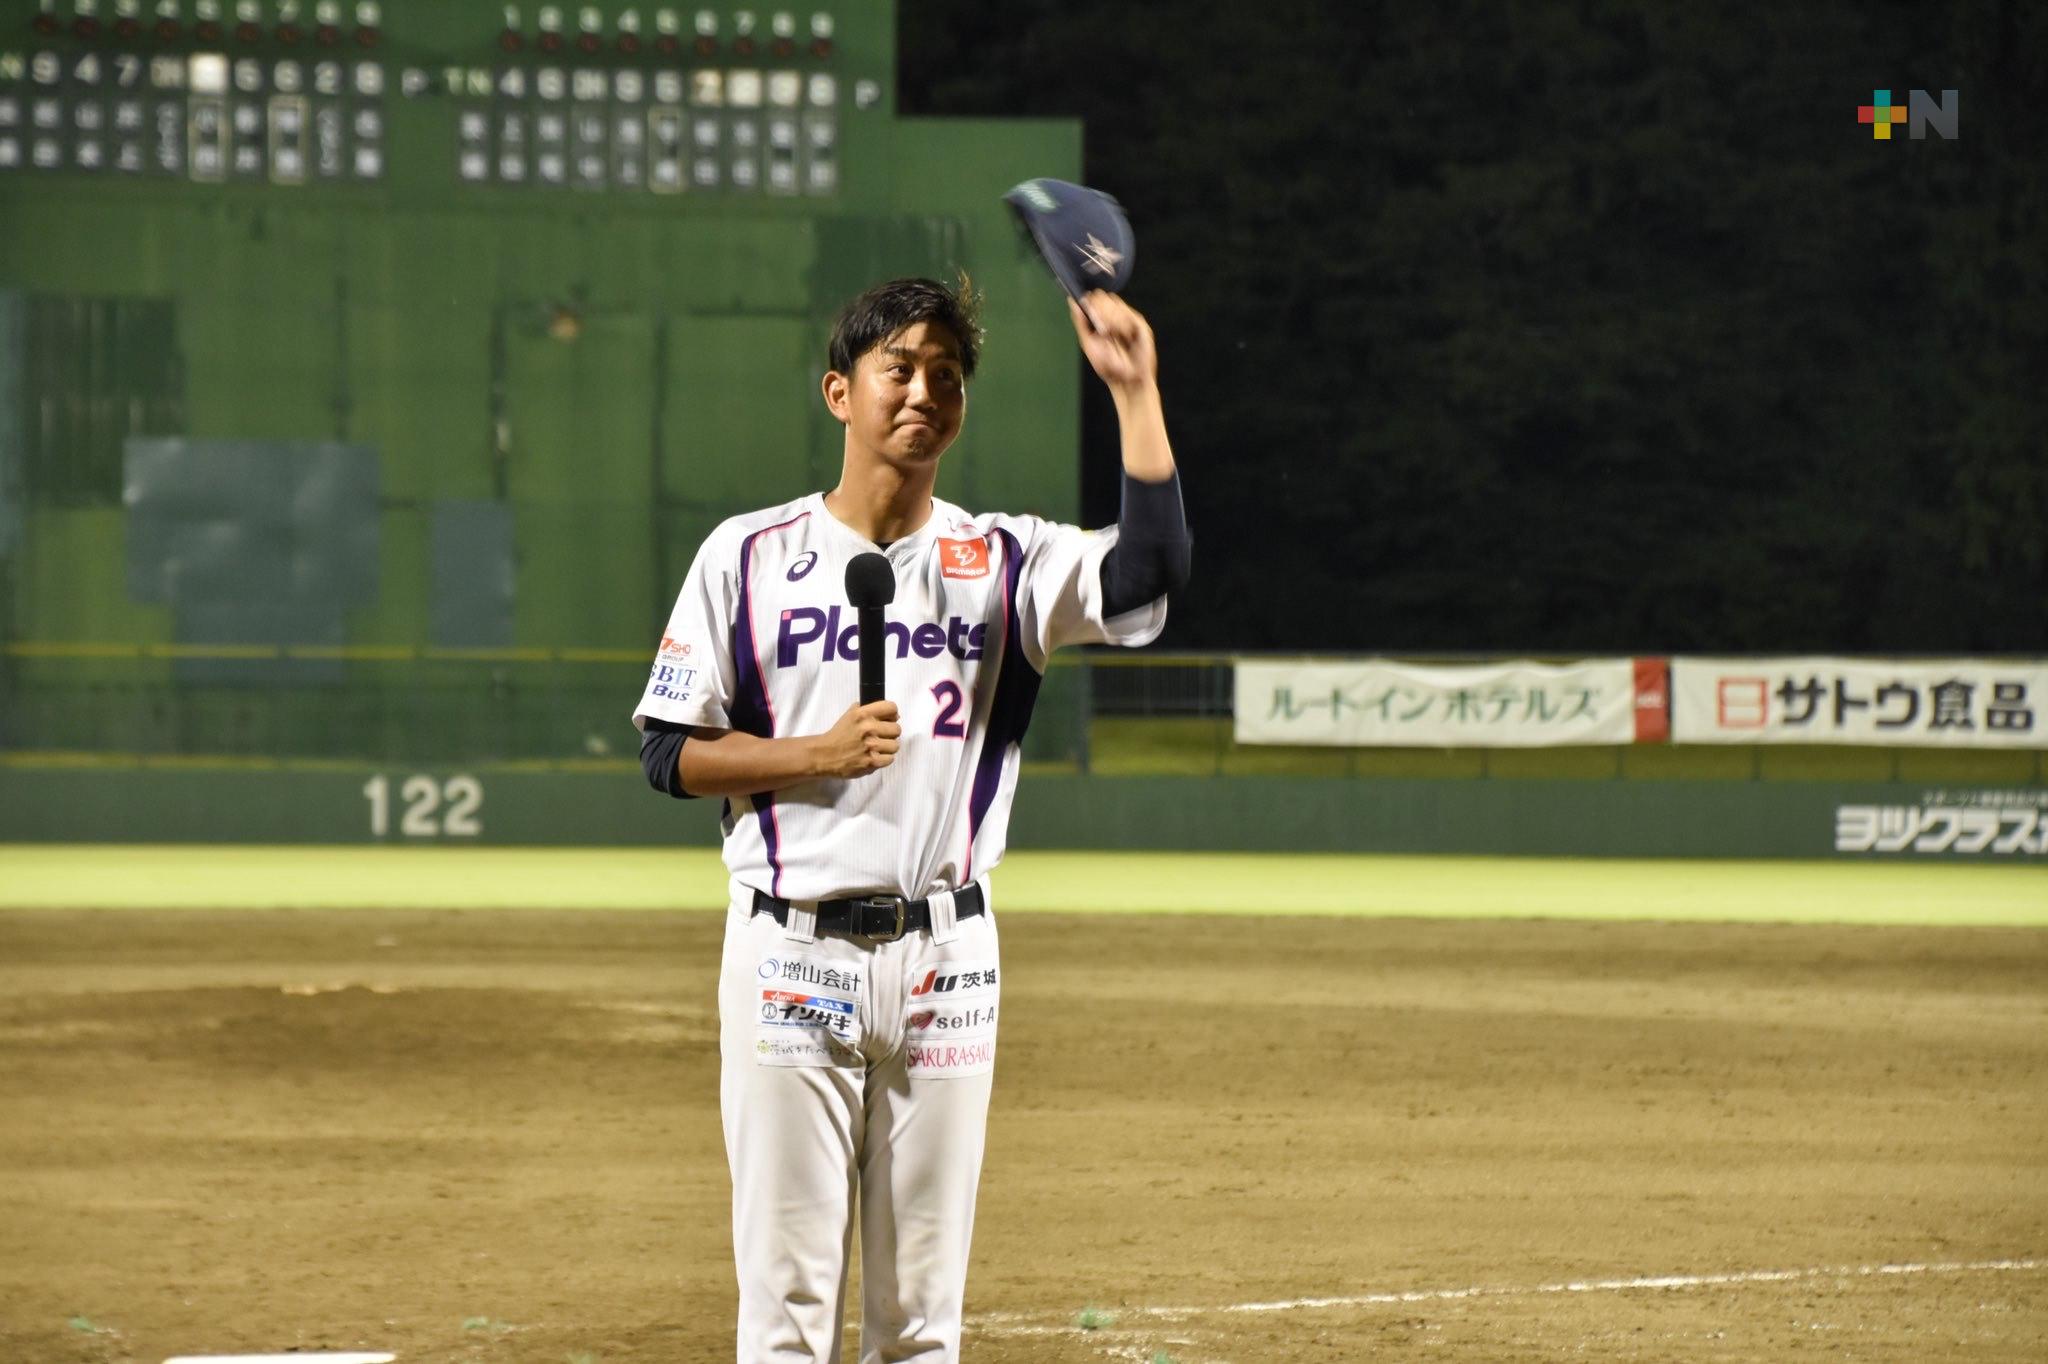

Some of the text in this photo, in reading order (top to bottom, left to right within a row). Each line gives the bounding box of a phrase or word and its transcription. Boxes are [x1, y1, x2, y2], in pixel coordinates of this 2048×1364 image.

[652, 684, 690, 701] Bus
[930, 679, 965, 741] 2
[363, 775, 483, 837] 122
[780, 961, 862, 992] 増山会計
[961, 968, 997, 990] 茨城
[779, 1004, 852, 1031] イソザキ
[816, 999, 846, 1011] TAX
